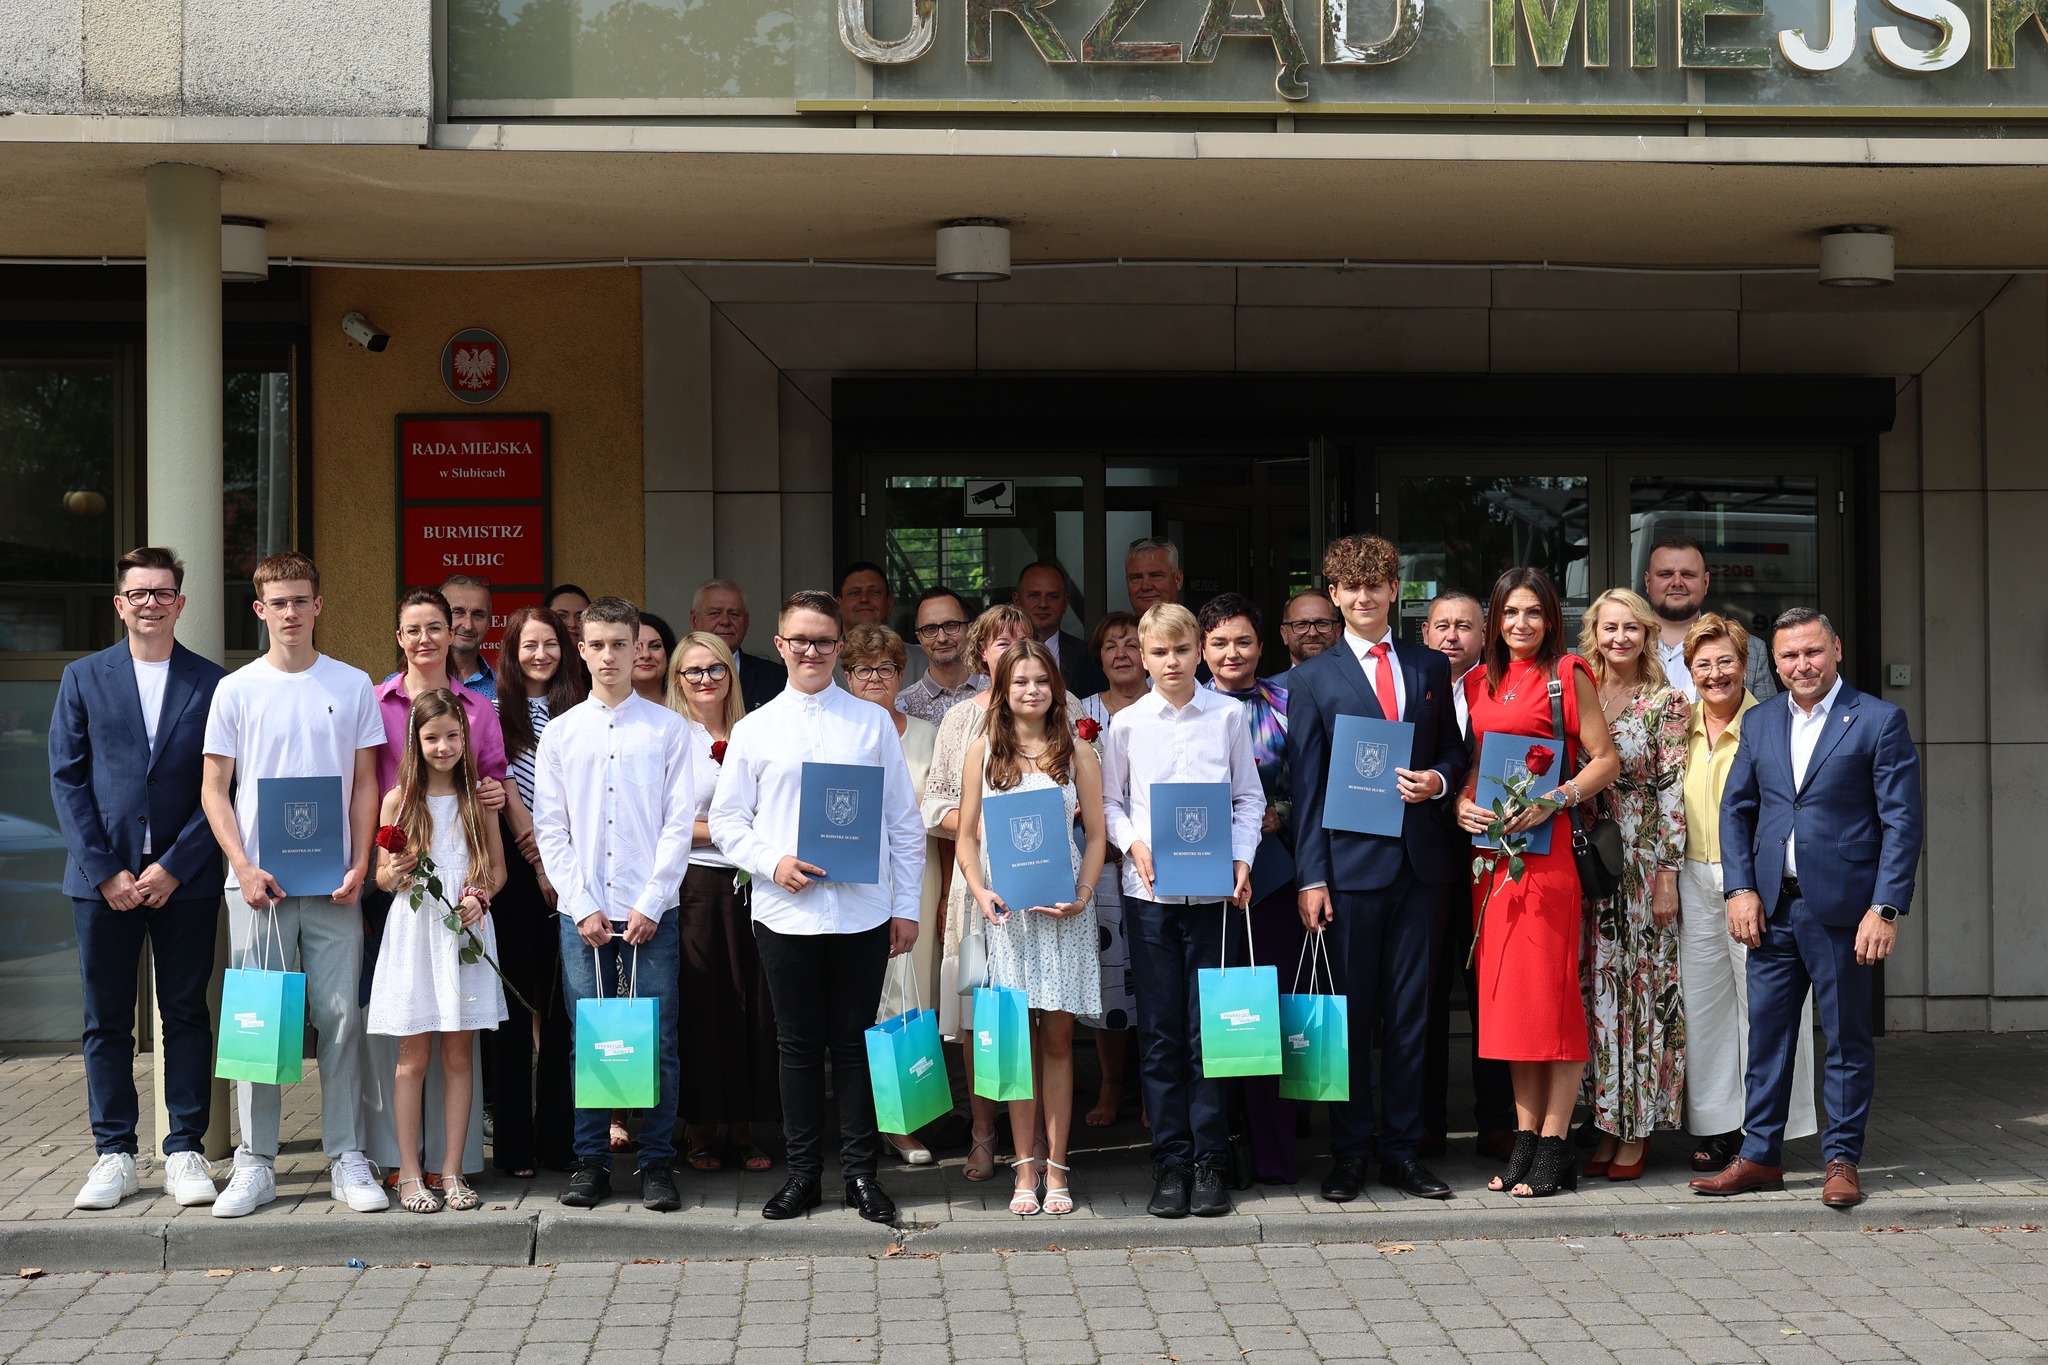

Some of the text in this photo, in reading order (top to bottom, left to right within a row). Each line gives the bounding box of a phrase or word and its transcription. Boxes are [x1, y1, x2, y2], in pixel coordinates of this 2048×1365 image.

[412, 441, 533, 455] RADA MIEJSKA
[439, 469, 449, 478] w
[423, 525, 524, 539] BURMISTRZ
[442, 552, 505, 566] SŁUBIC
